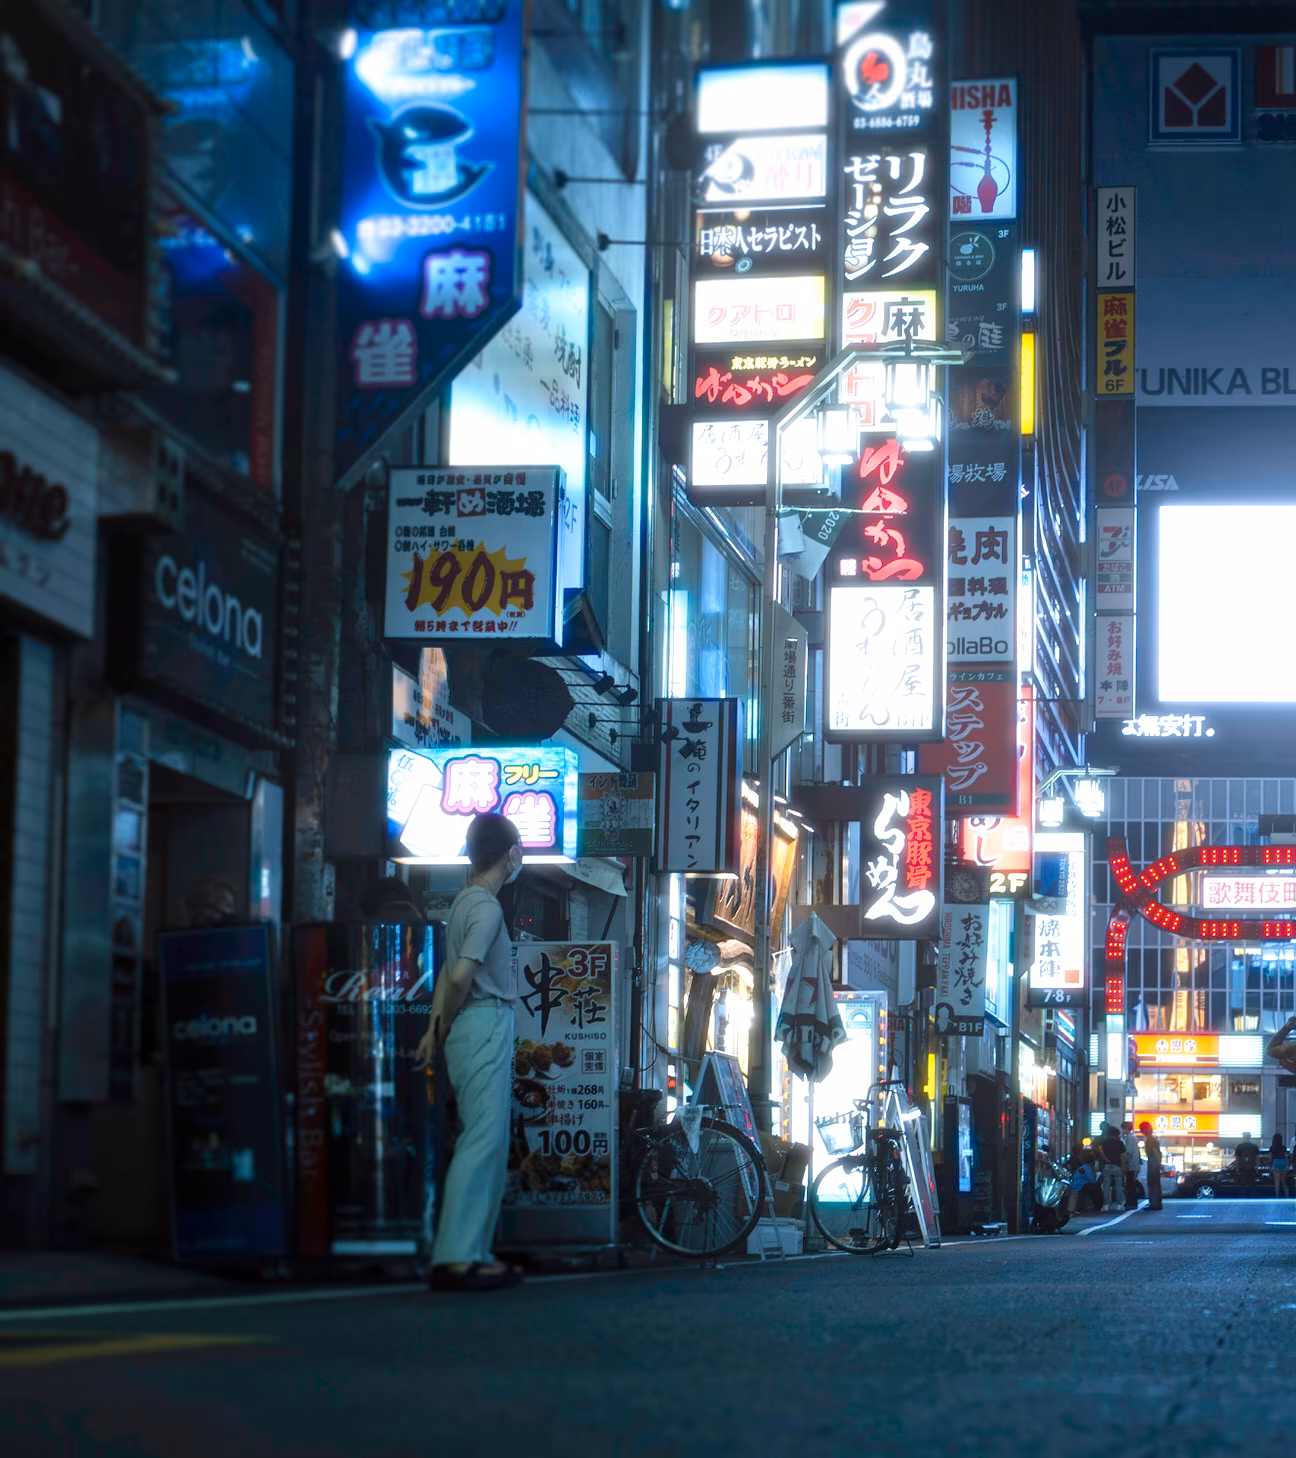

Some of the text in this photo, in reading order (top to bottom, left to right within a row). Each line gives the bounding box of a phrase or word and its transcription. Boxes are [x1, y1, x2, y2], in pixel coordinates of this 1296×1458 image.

[844, 154, 882, 280] ゼーション
[880, 153, 930, 278] リラク
[701, 224, 821, 256] 日本人セラピスト
[1106, 193, 1126, 281] 小松ビル
[953, 284, 984, 292] YURUHA
[707, 303, 796, 326] クアトロ
[1105, 379, 1124, 392] 6F
[1134, 367, 1250, 395] UNIKA
[820, 510, 842, 541] 2020
[404, 551, 536, 613] 190円
[1104, 584, 1126, 593] ATM
[155, 555, 262, 658] celona
[895, 588, 926, 697] 居酒屋
[1107, 621, 1122, 676] お好み焼
[780, 637, 798, 724] 劇場通り一番街
[1100, 679, 1129, 692] 本陣
[947, 686, 988, 791] ステップ
[503, 764, 559, 785] フリー
[959, 795, 974, 804] B1
[906, 788, 933, 890] 東京豚骨
[990, 872, 1027, 893] 2F
[567, 950, 606, 977] 3F
[954, 912, 984, 1006] お好み焼き
[173, 1014, 258, 1041] celona
[959, 1022, 983, 1033] B1F
[539, 1130, 608, 1154] 100円
